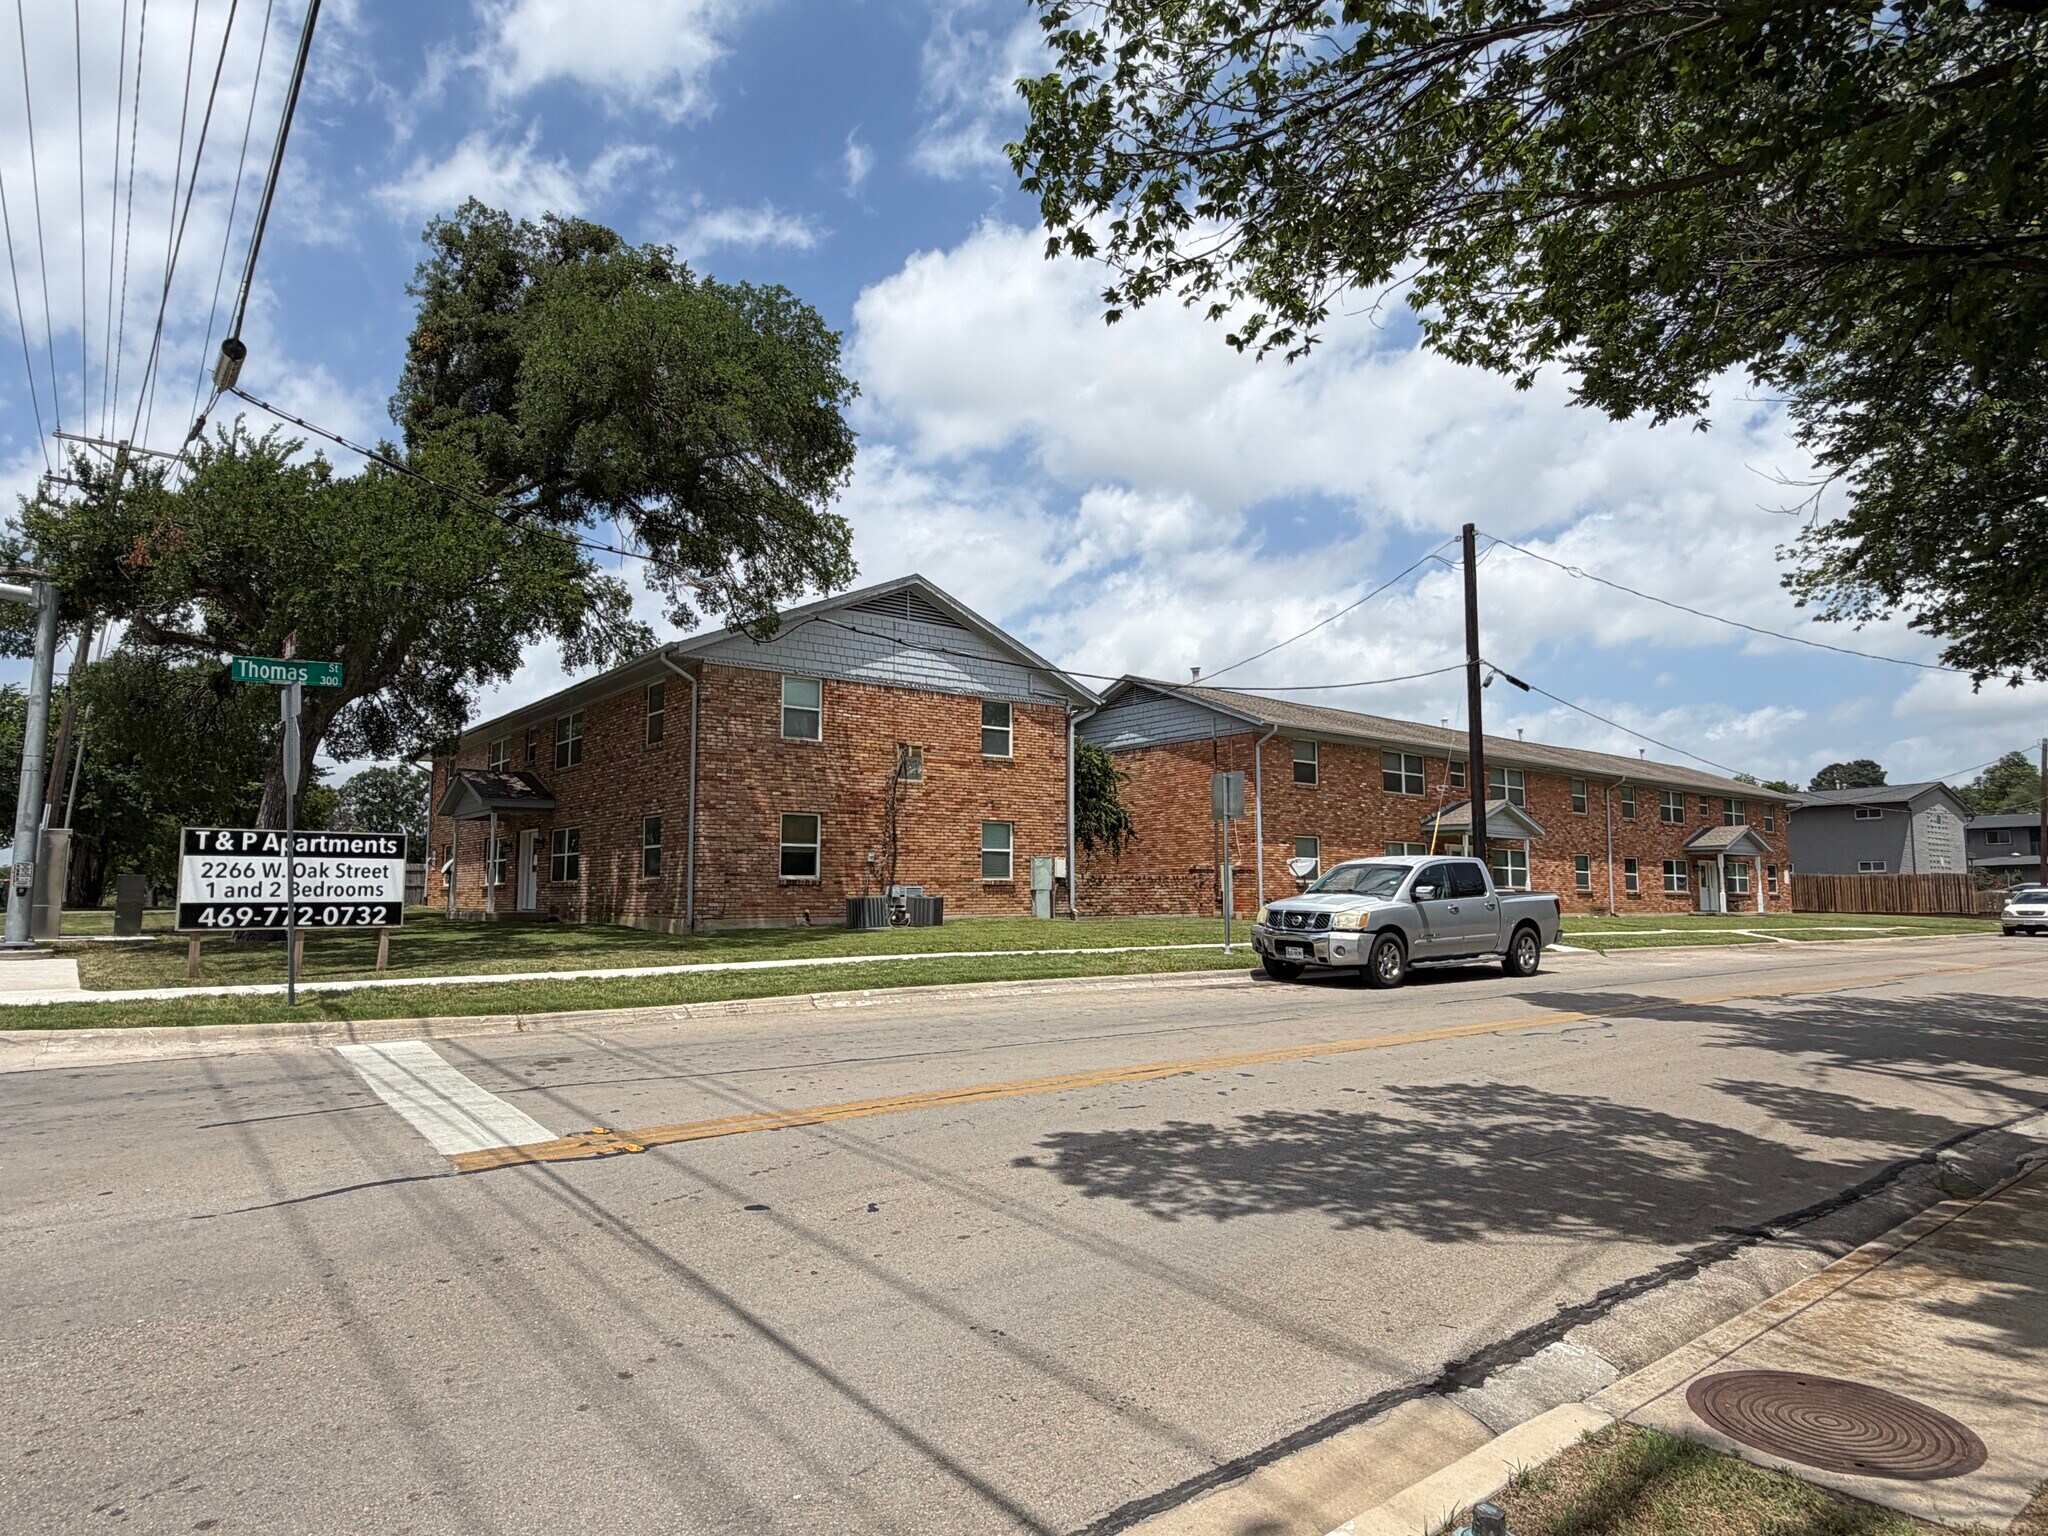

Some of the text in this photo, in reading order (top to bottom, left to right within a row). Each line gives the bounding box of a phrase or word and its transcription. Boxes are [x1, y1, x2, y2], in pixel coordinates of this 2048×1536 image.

[238, 660, 308, 681] Thomas
[328, 663, 339, 673] St
[320, 676, 339, 686] 300
[195, 831, 397, 857] T & P Apartments
[201, 862, 389, 880] 2266 W. Oak Street
[206, 881, 384, 898] 1 and 2 Bedrooms
[198, 905, 387, 927] 469-772-0732
